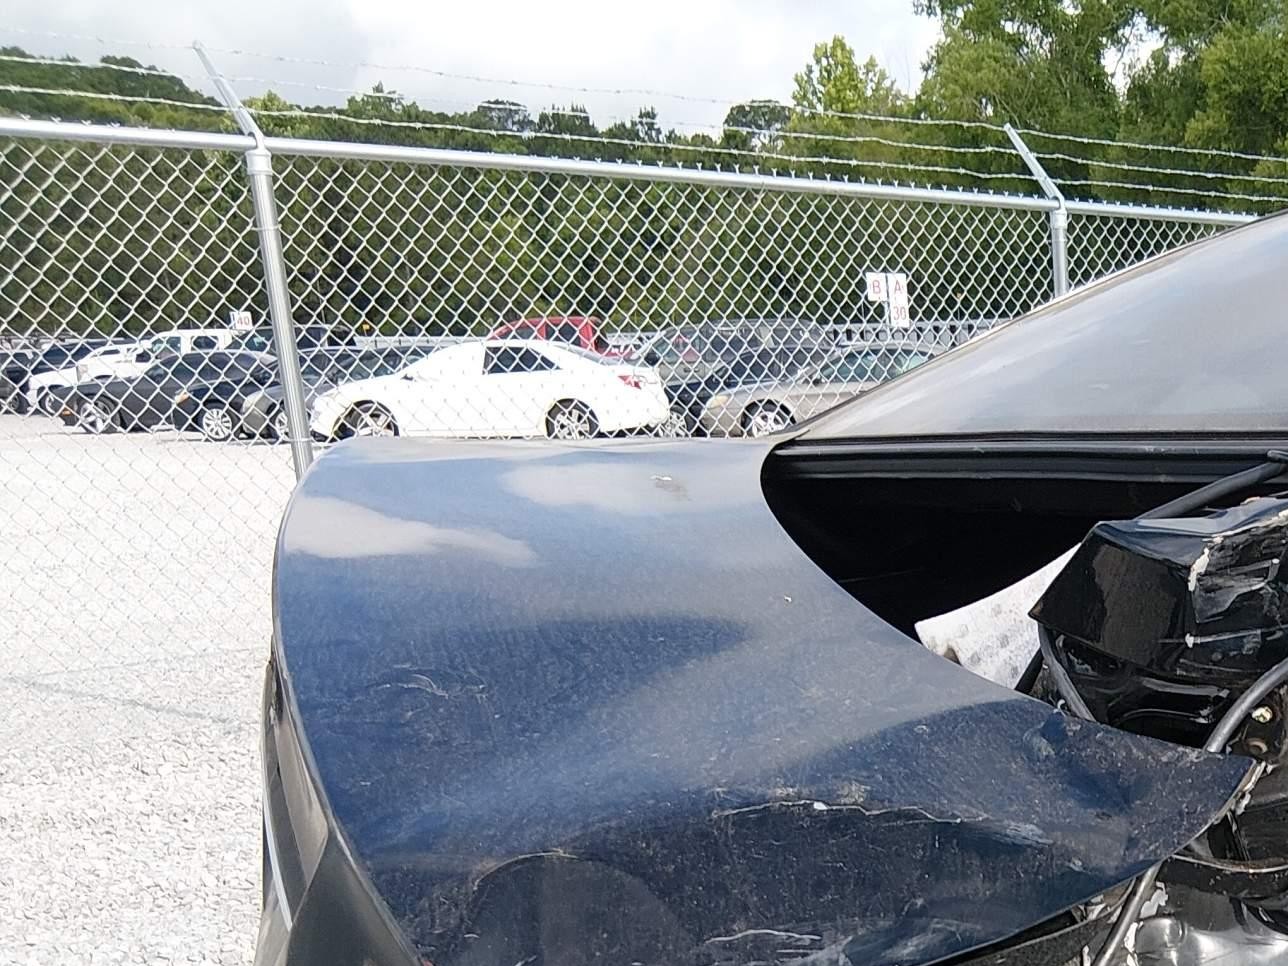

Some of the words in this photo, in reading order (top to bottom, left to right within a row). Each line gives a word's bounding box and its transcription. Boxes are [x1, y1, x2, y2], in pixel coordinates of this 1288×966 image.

[872, 280, 881, 294] B
[894, 280, 902, 294] A
[893, 306, 906, 320] 30
[237, 316, 250, 325] 40
